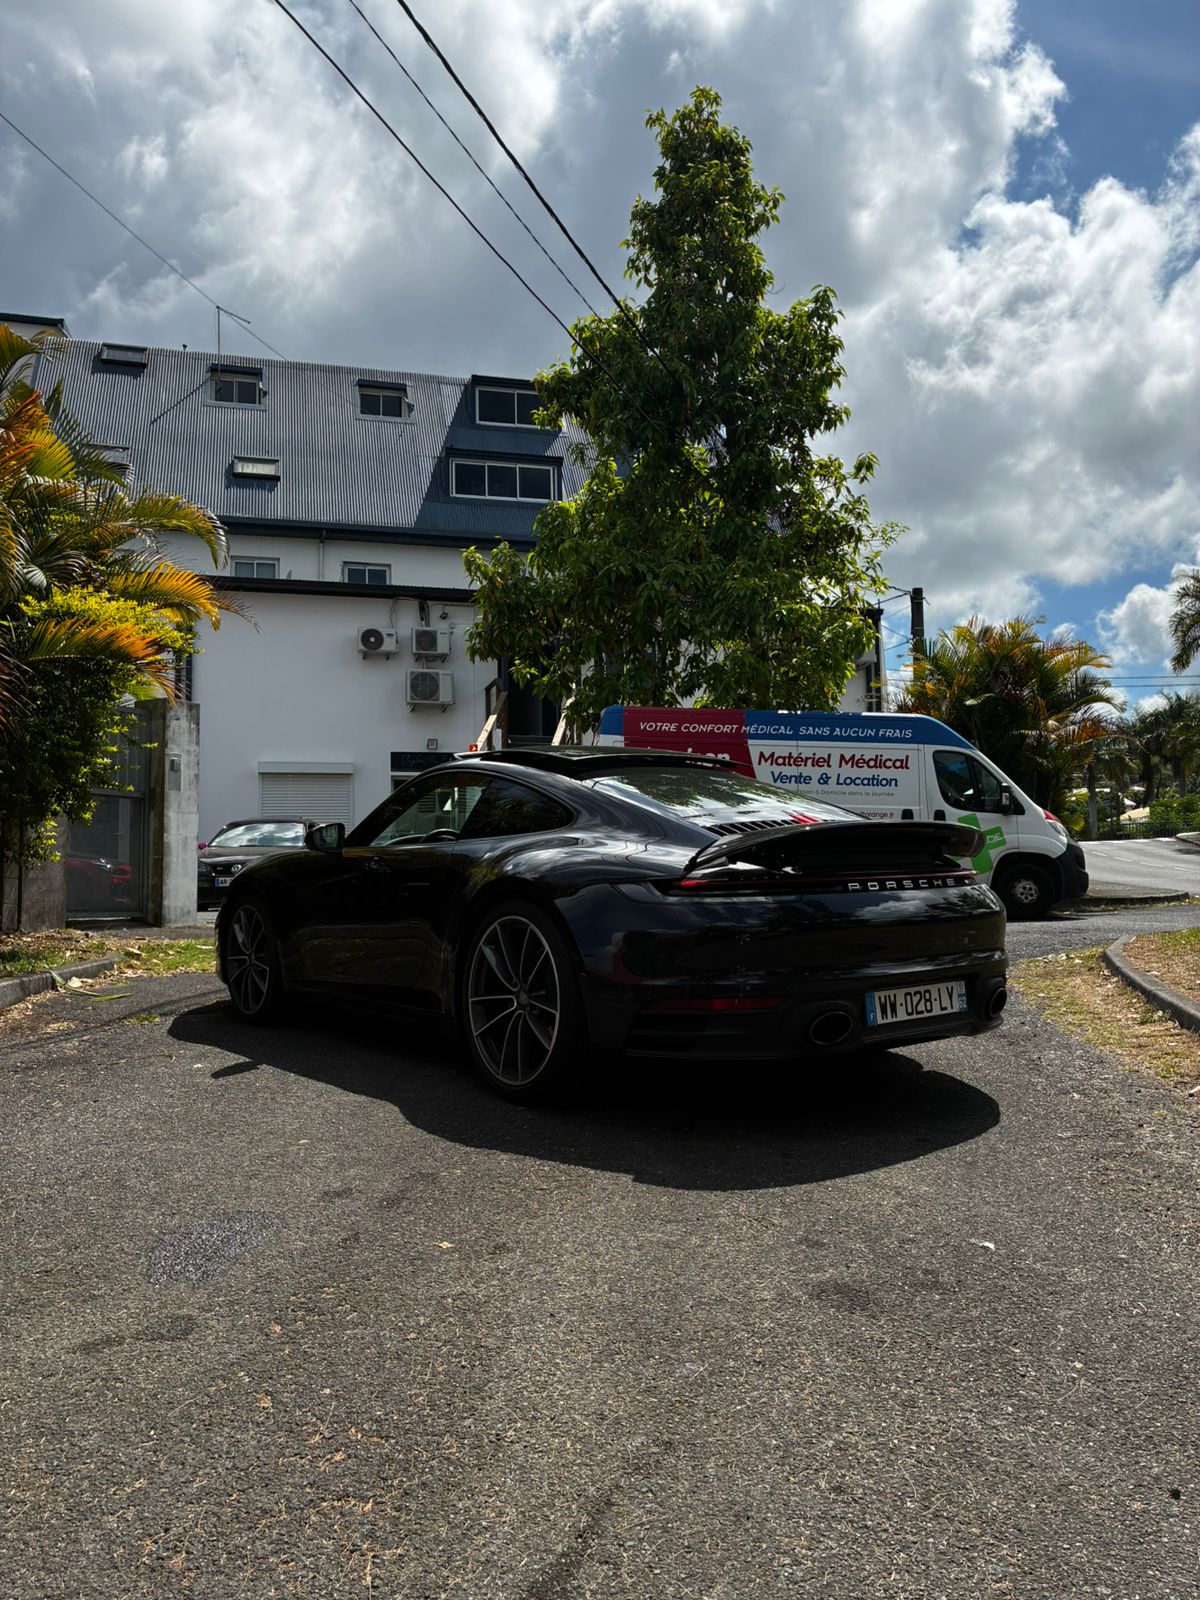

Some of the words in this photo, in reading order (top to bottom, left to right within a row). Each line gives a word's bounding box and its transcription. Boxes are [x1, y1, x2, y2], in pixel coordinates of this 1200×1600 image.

[640, 722, 678, 732] VOTRE
[681, 723, 738, 734] CONFORT
[741, 723, 793, 735] MÉDICAL
[799, 726, 830, 736] SANS
[833, 727, 876, 737] AUCUN
[879, 728, 912, 738] FRAIS
[758, 751, 832, 768] Matériel
[838, 753, 910, 770] Médical
[771, 771, 812, 785] Vente
[818, 772, 832, 786] &
[836, 773, 898, 787] Location
[848, 878, 956, 891] PORSCHE
